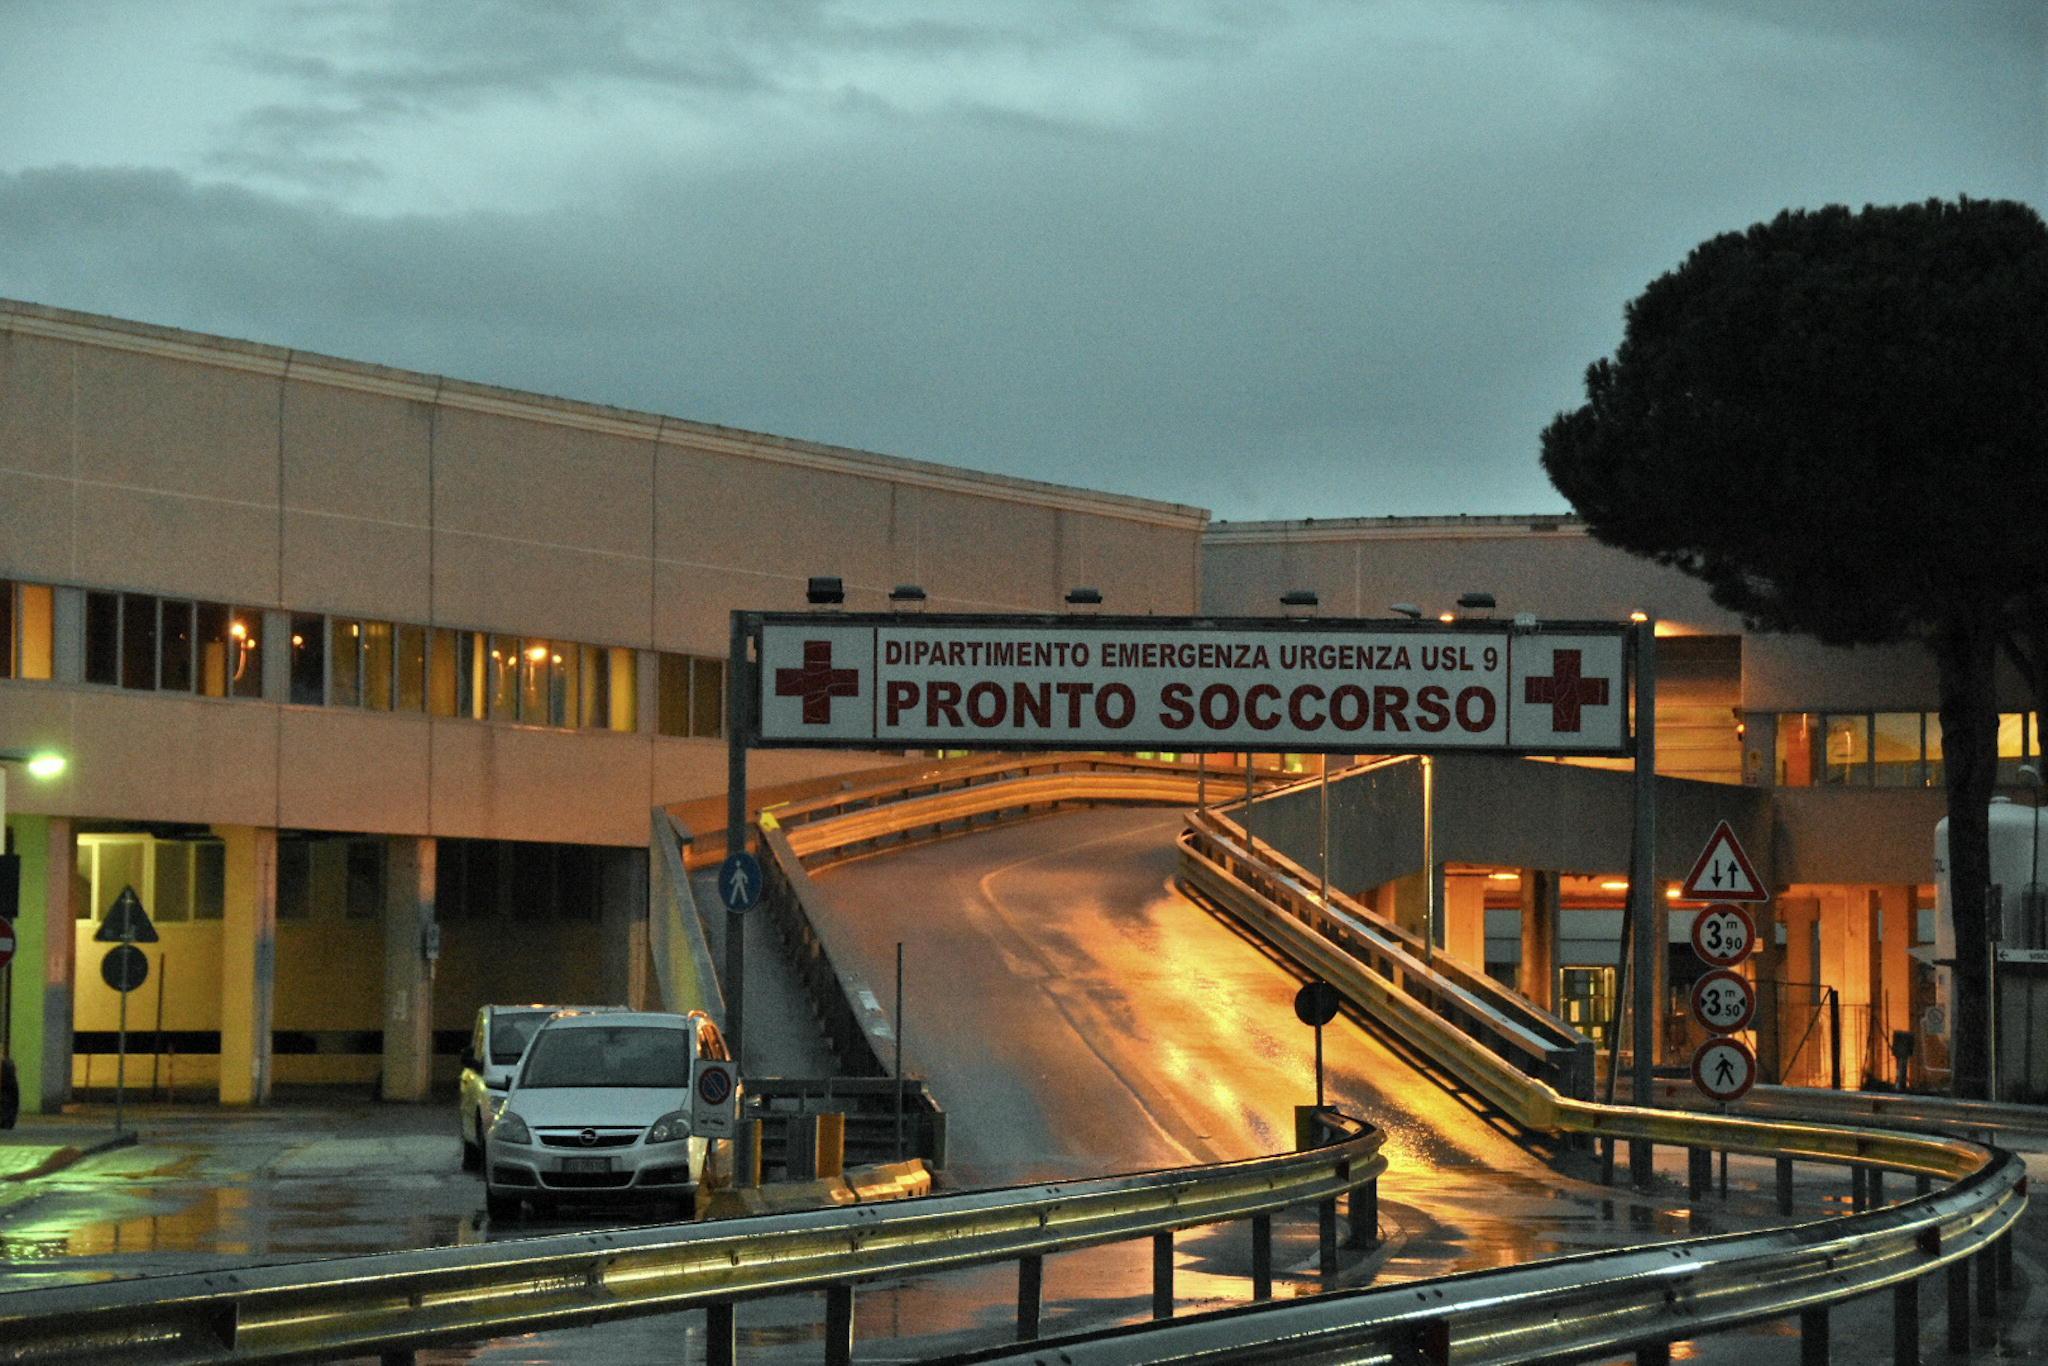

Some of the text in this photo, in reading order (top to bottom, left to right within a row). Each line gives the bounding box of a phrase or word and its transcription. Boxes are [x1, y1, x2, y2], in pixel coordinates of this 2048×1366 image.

[886, 641, 1498, 672] DIPARTIMENTO EMERGENZA URGENZA USL 9
[886, 681, 1496, 733] PRONTO SOCCORSO
